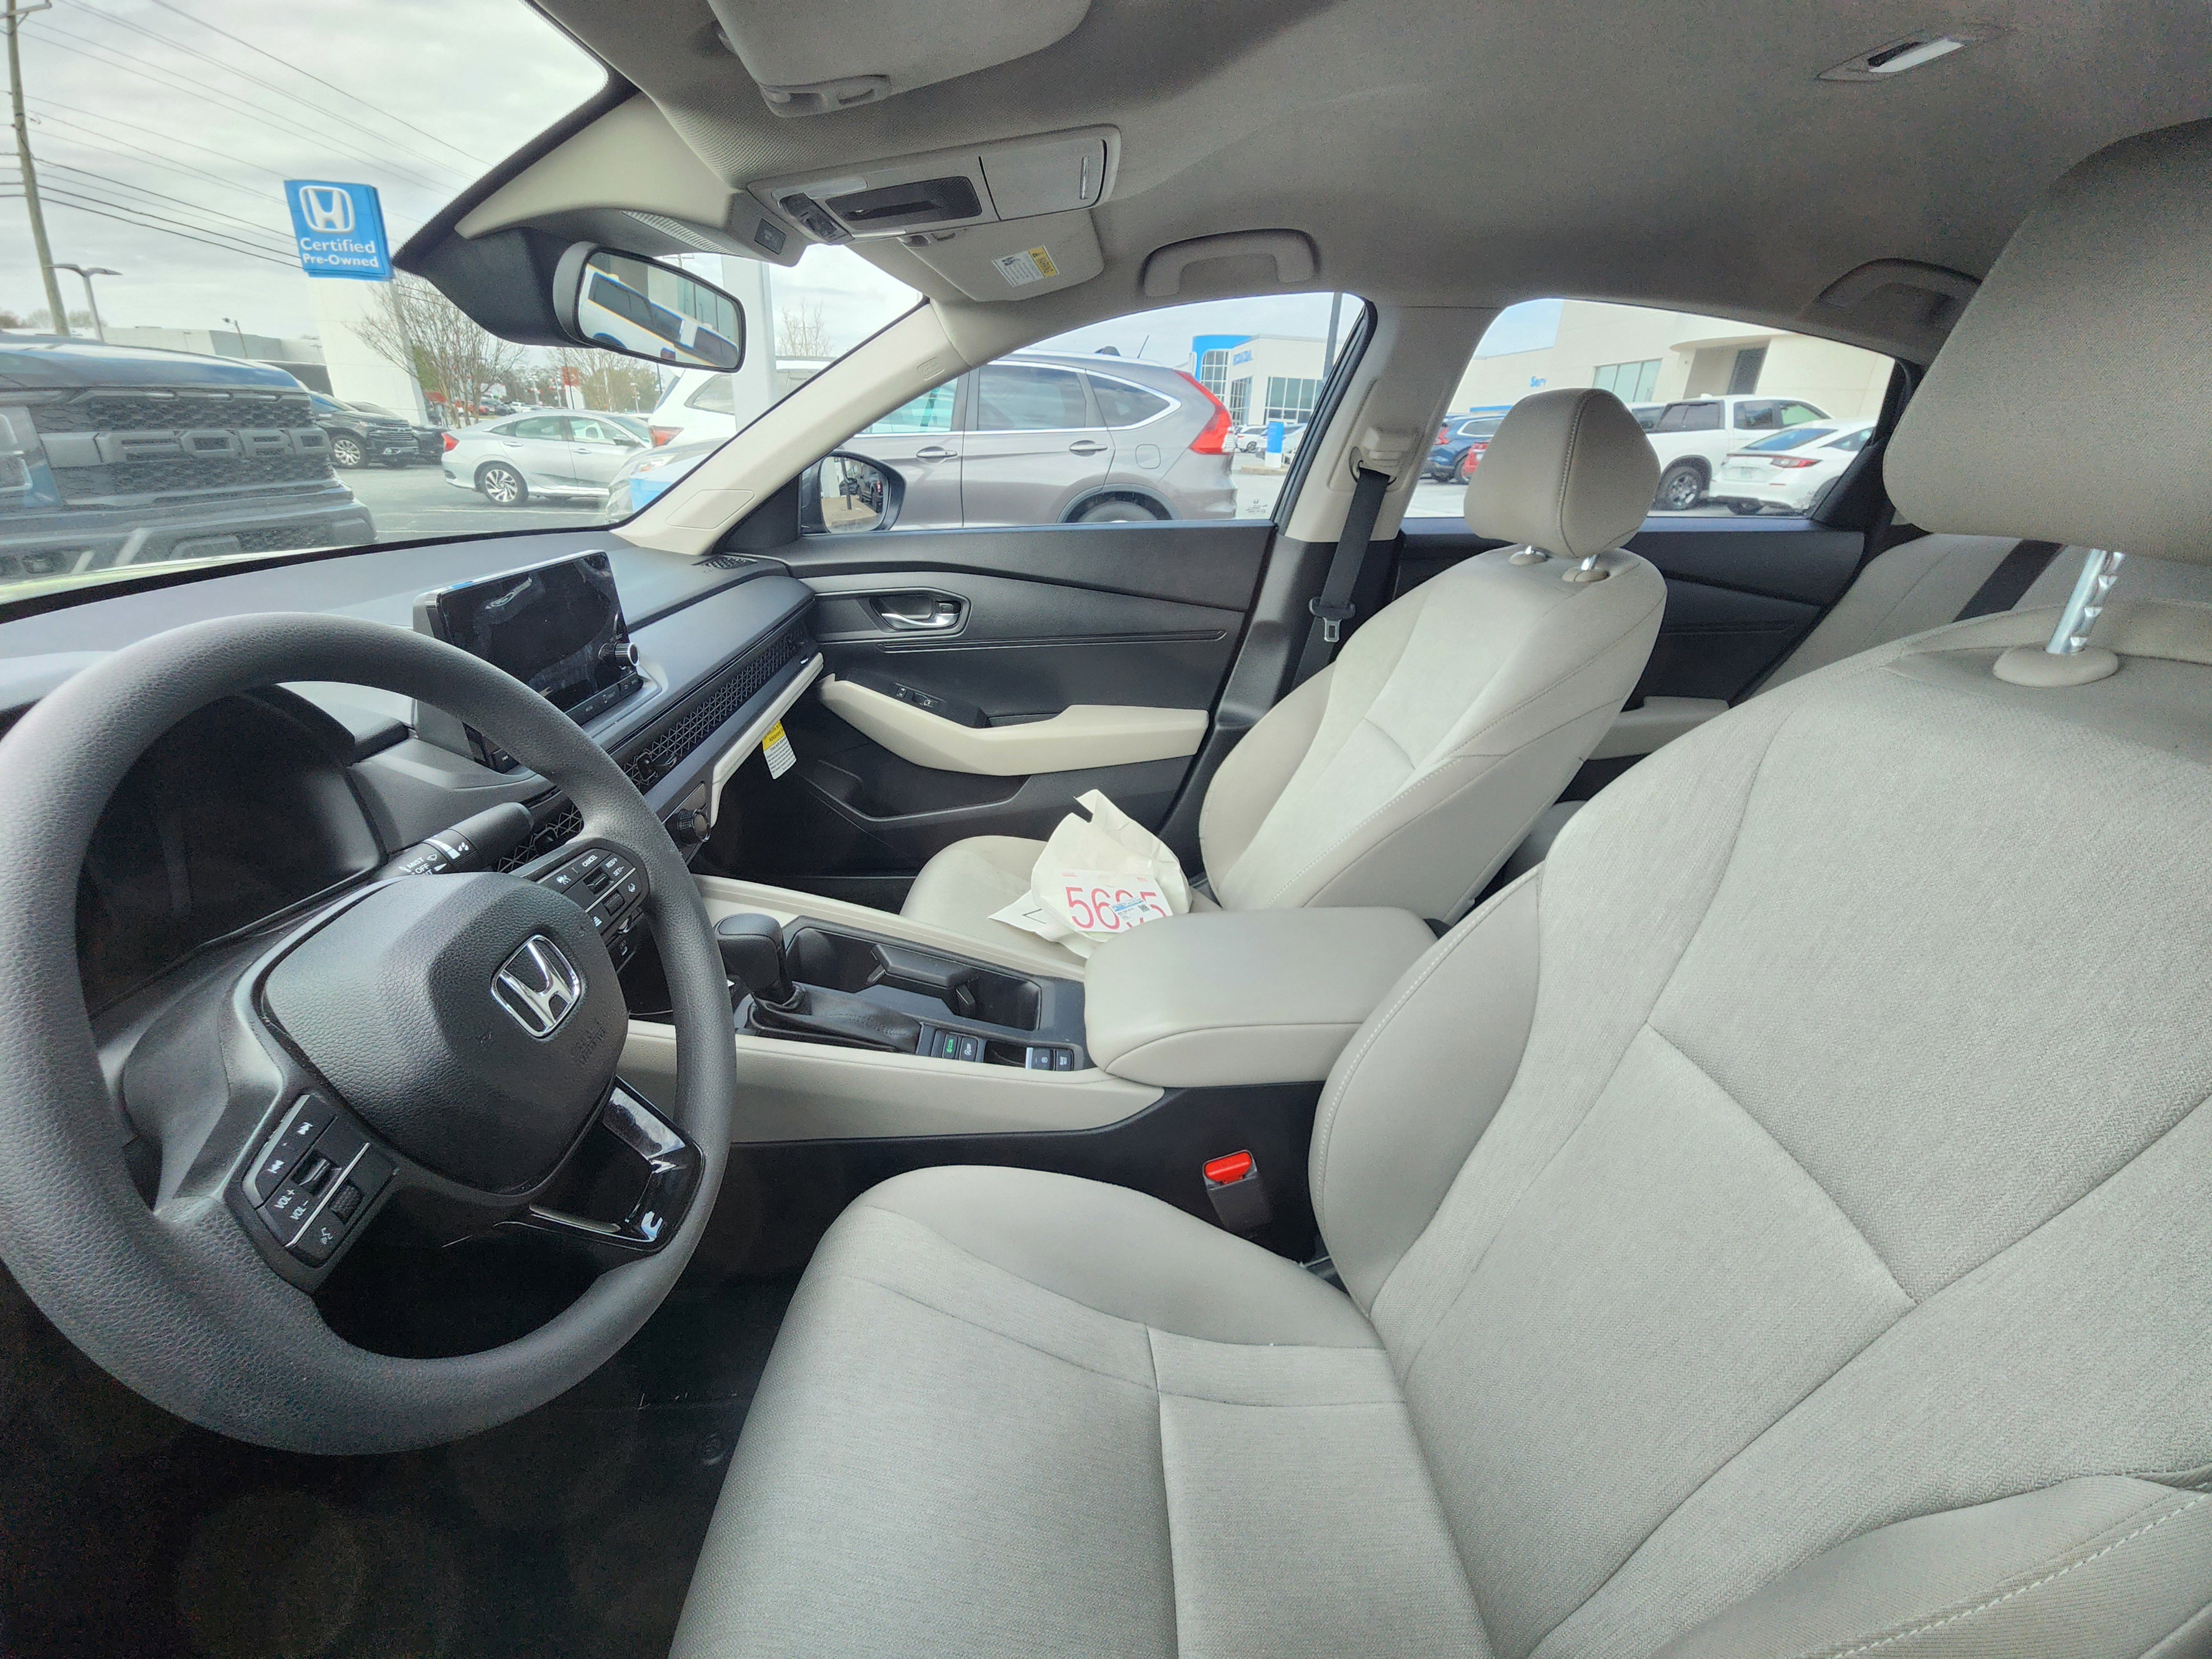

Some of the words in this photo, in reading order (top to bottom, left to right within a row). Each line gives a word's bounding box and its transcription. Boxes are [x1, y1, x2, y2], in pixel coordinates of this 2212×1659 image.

[300, 238, 376, 253] Certified
[302, 253, 379, 268] Pre-Owned
[99, 427, 333, 464] FORD
[407, 857, 424, 868] MIST
[582, 855, 598, 867] CANCEL
[415, 863, 429, 874] OFF
